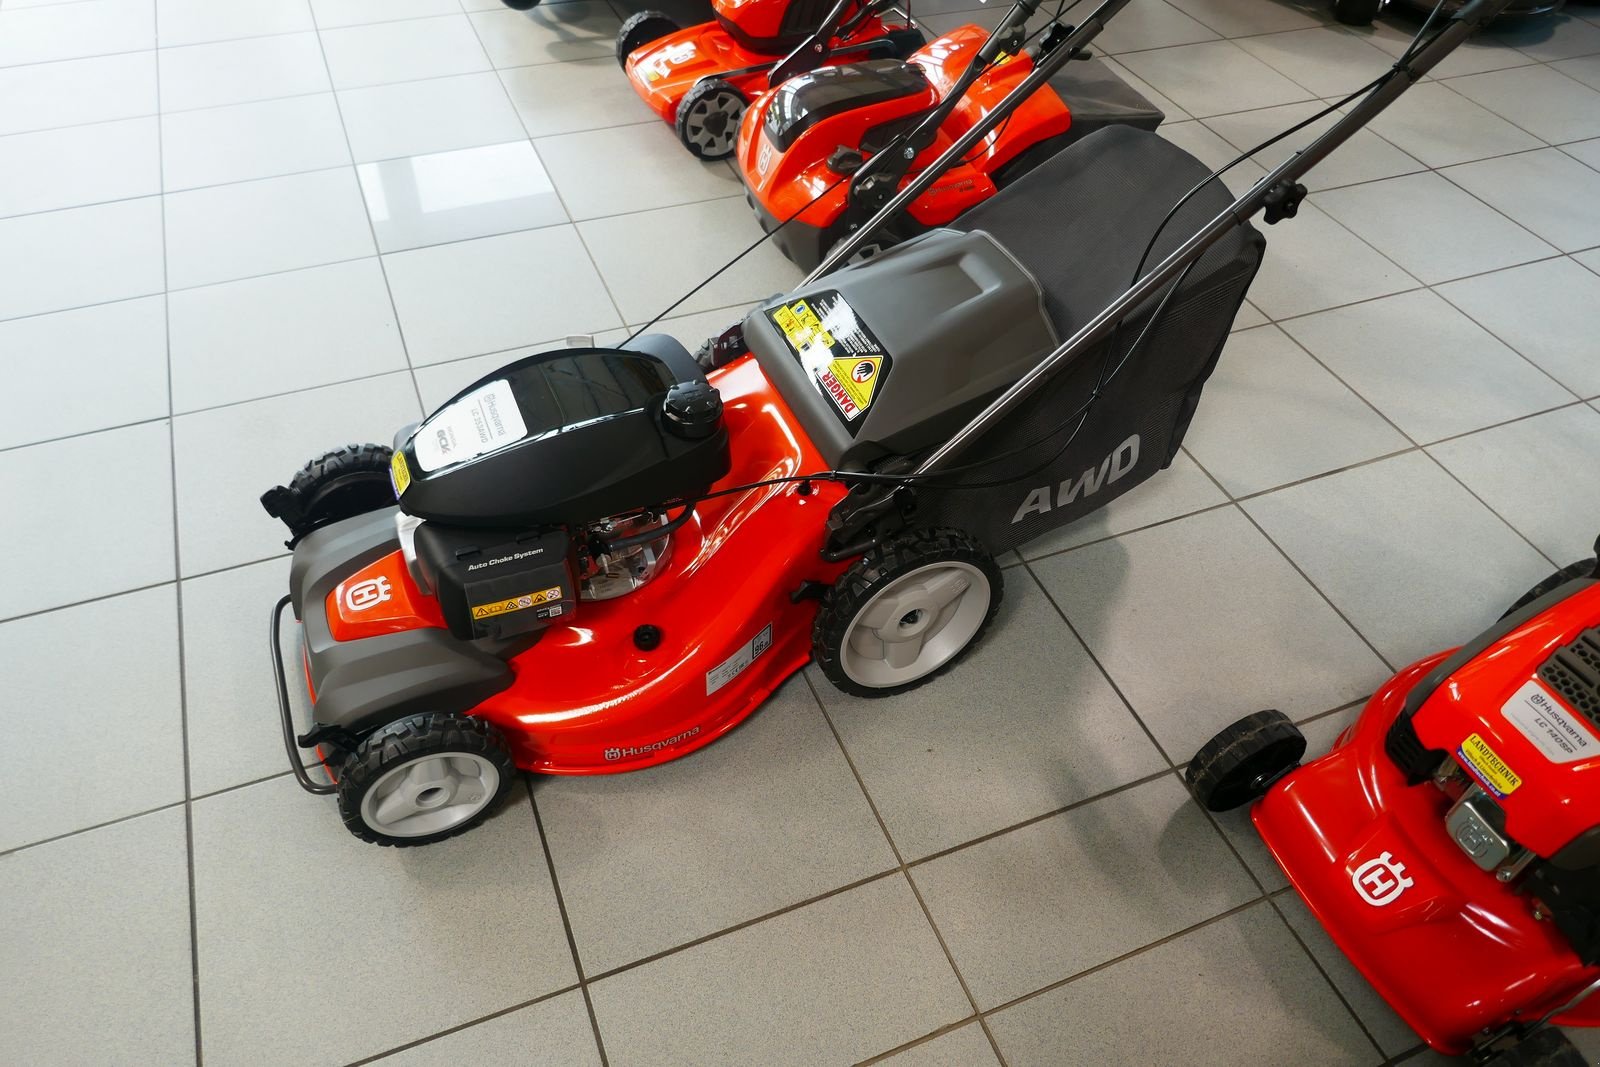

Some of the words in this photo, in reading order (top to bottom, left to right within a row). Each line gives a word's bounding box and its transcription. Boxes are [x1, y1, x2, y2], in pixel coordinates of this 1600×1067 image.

[821, 371, 856, 414] DANGER
[488, 400, 506, 436] Husqvarna
[1011, 433, 1140, 525] AWD
[468, 562, 488, 572] Auto
[489, 555, 513, 567] Choke
[514, 547, 544, 561] System
[622, 726, 700, 758] Husqvarna
[1534, 717, 1548, 729] LC
[1546, 727, 1574, 754] 140SP
[1540, 701, 1588, 748] Husqvarna
[1469, 735, 1519, 787] LANDTECHNIK
